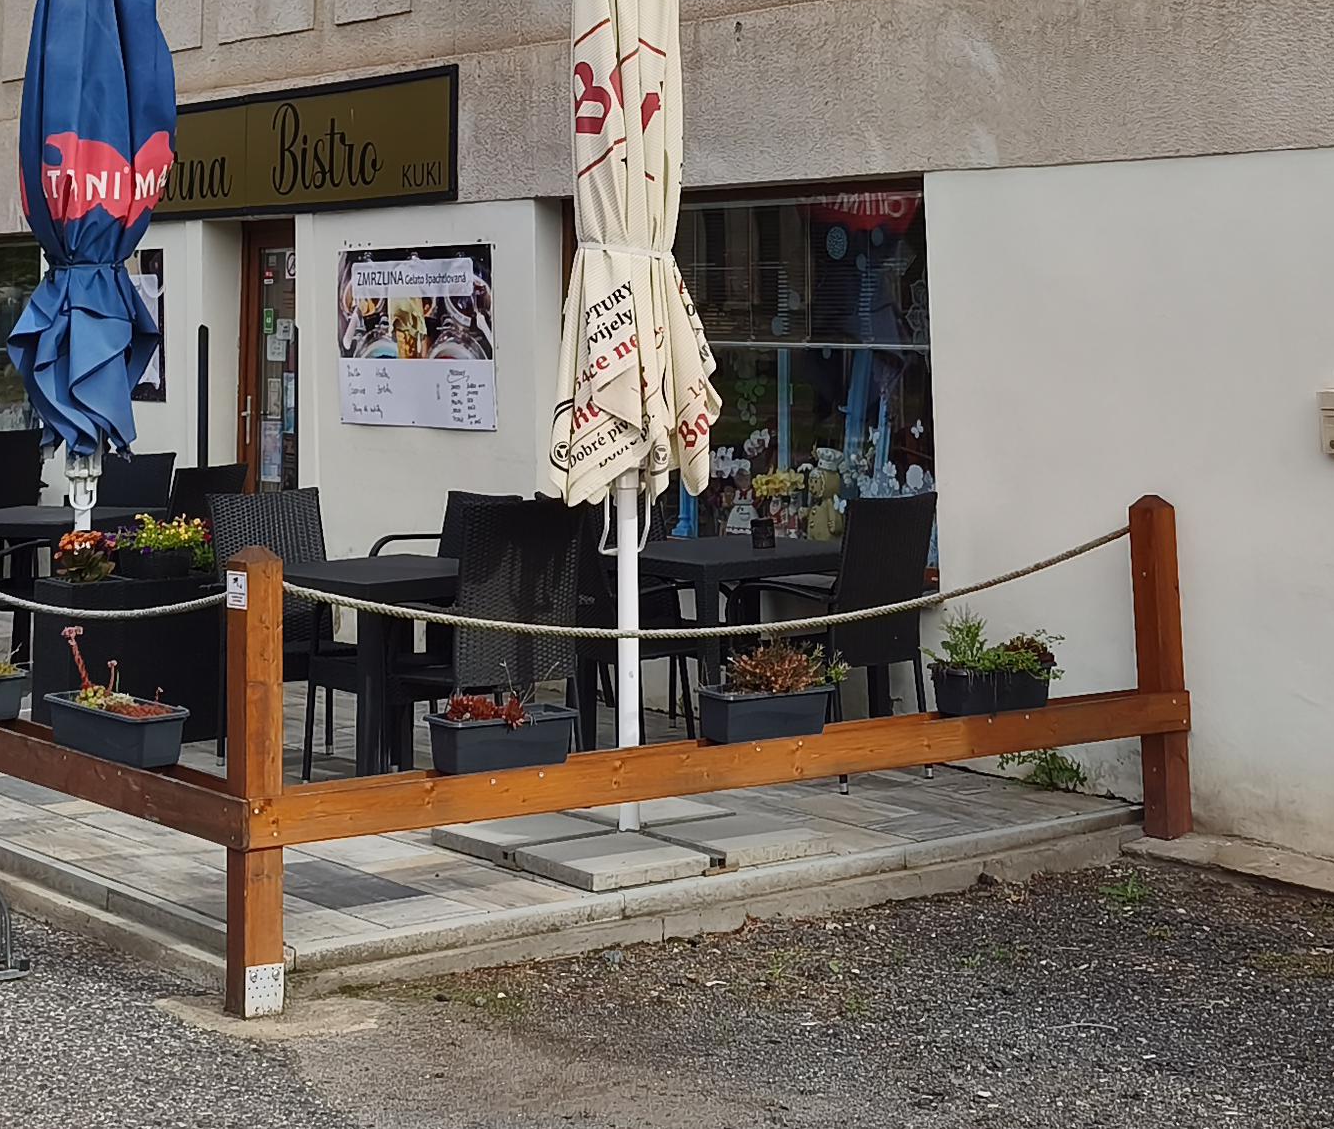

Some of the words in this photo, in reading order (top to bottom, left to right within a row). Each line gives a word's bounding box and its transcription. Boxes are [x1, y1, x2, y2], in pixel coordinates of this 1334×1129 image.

[271, 102, 384, 196] Bistro
[402, 161, 442, 188] KUKI
[357, 271, 404, 287] ZMRZLINA
